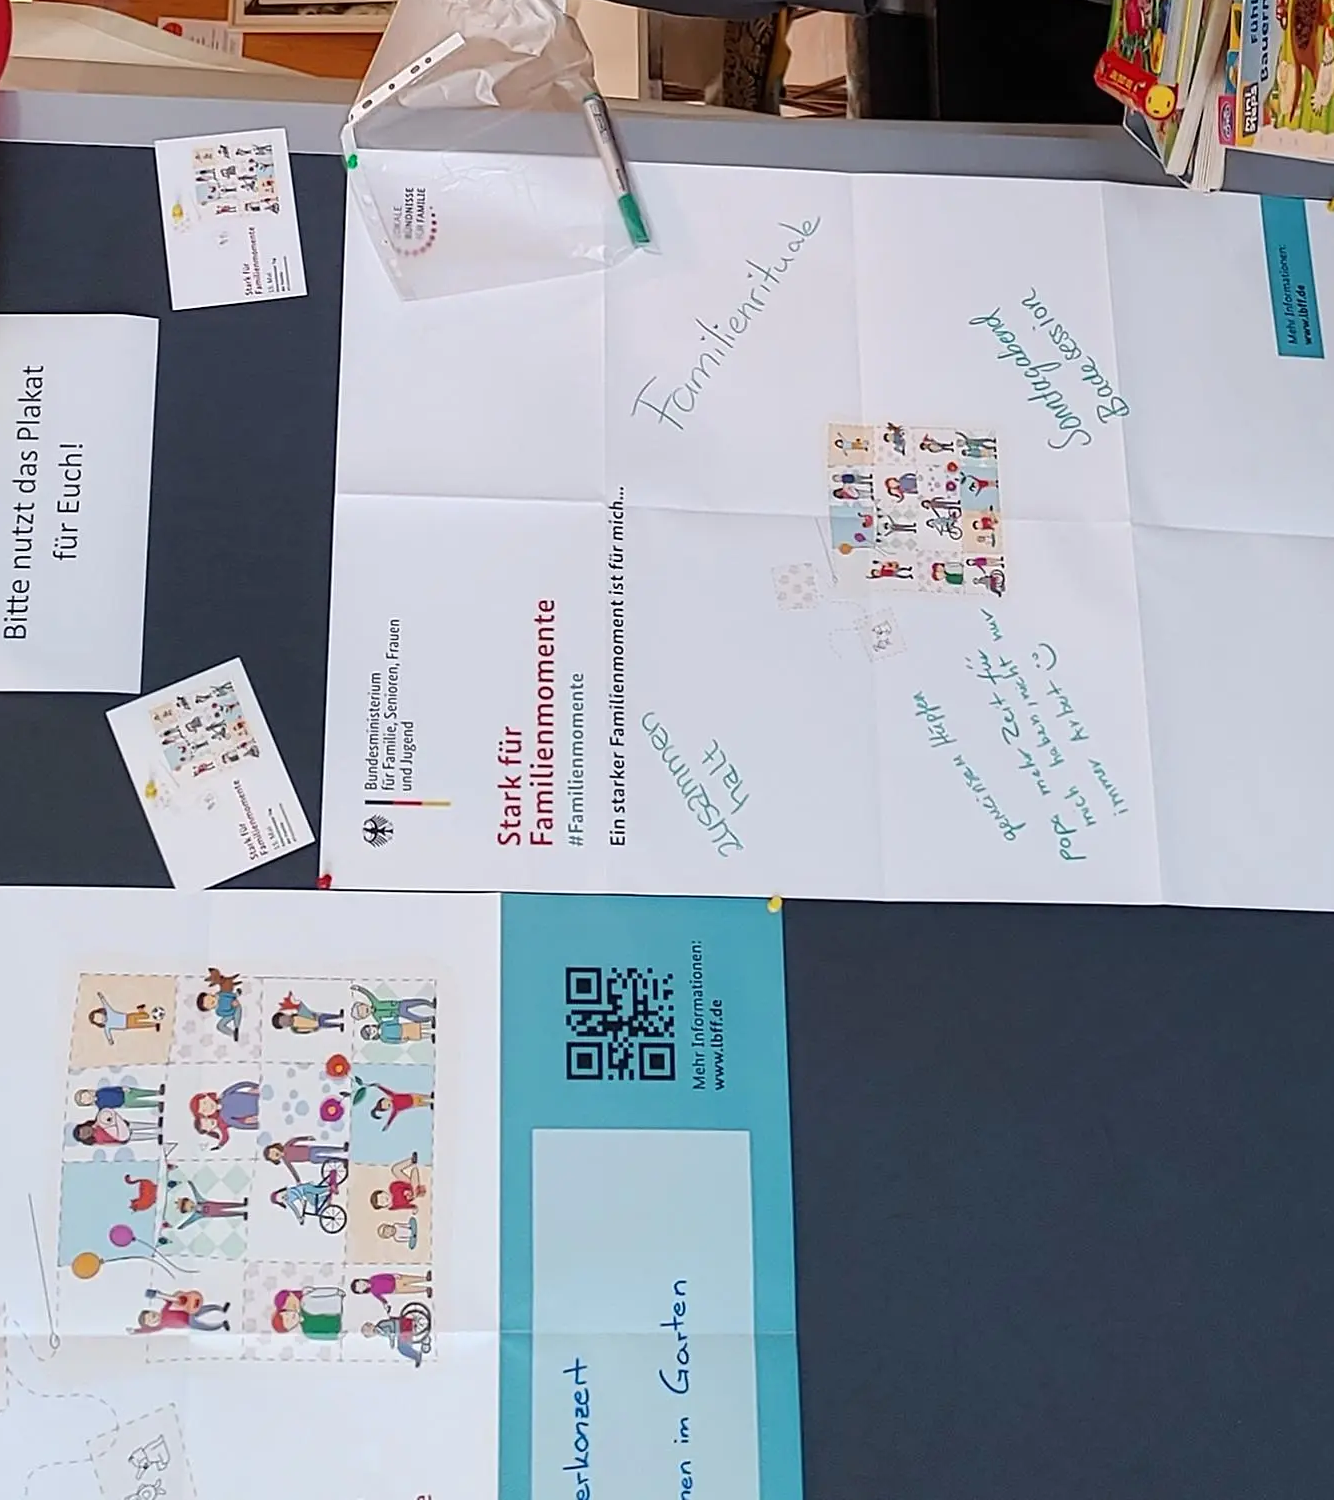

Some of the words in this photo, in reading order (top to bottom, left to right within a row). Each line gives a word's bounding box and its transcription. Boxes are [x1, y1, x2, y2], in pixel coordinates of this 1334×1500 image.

[1243, 88, 1255, 134] mini
[391, 205, 403, 240] LOKALE
[402, 187, 415, 240] BÜNDNISSE
[415, 187, 427, 224] FAMILIE
[247, 226, 263, 295] Familienmomente
[630, 215, 822, 432] Familienrituale
[17, 364, 45, 440] Plakat
[968, 306, 1093, 450] Sonntagabend
[13, 449, 39, 494] das
[56, 442, 84, 513] Euch!
[9, 502, 35, 570] nutzt
[608, 486, 626, 542] mich...
[52, 522, 79, 560] für
[608, 544, 625, 570] für
[3, 579, 31, 639] Bitte
[609, 574, 625, 596] ist
[386, 618, 401, 660] Frauen
[980, 607, 1003, 642] nur
[384, 662, 401, 720] Senioren,
[609, 600, 626, 747] Familienmoment
[965, 648, 1002, 686] für
[364, 671, 382, 791] Bundesministerium
[529, 599, 555, 847] Familienmomente
[988, 692, 1020, 745] Zeit
[1046, 678, 1090, 742] Arbeit
[382, 721, 399, 770] Familie,
[400, 720, 417, 765] Jugend
[498, 726, 523, 766] für
[567, 672, 585, 847] #Familienmomente
[381, 772, 398, 791] für
[399, 767, 414, 792] und
[610, 751, 627, 814] starker
[640, 711, 744, 857] zusammen
[702, 739, 750, 815] halt
[1016, 747, 1052, 796] mehr
[1087, 758, 1128, 816] immer
[232, 779, 268, 856] Familienmomente
[237, 822, 252, 837] für
[496, 775, 523, 846] Stark
[610, 818, 626, 847] Ein
[1064, 785, 1097, 827] mich
[241, 837, 259, 860] Stark
[687, 940, 706, 1048] Informationen:
[690, 1053, 708, 1090] Mehr
[707, 999, 727, 1091] www.lbff.de
[659, 1279, 691, 1395] Garten
[672, 1416, 691, 1444] im
